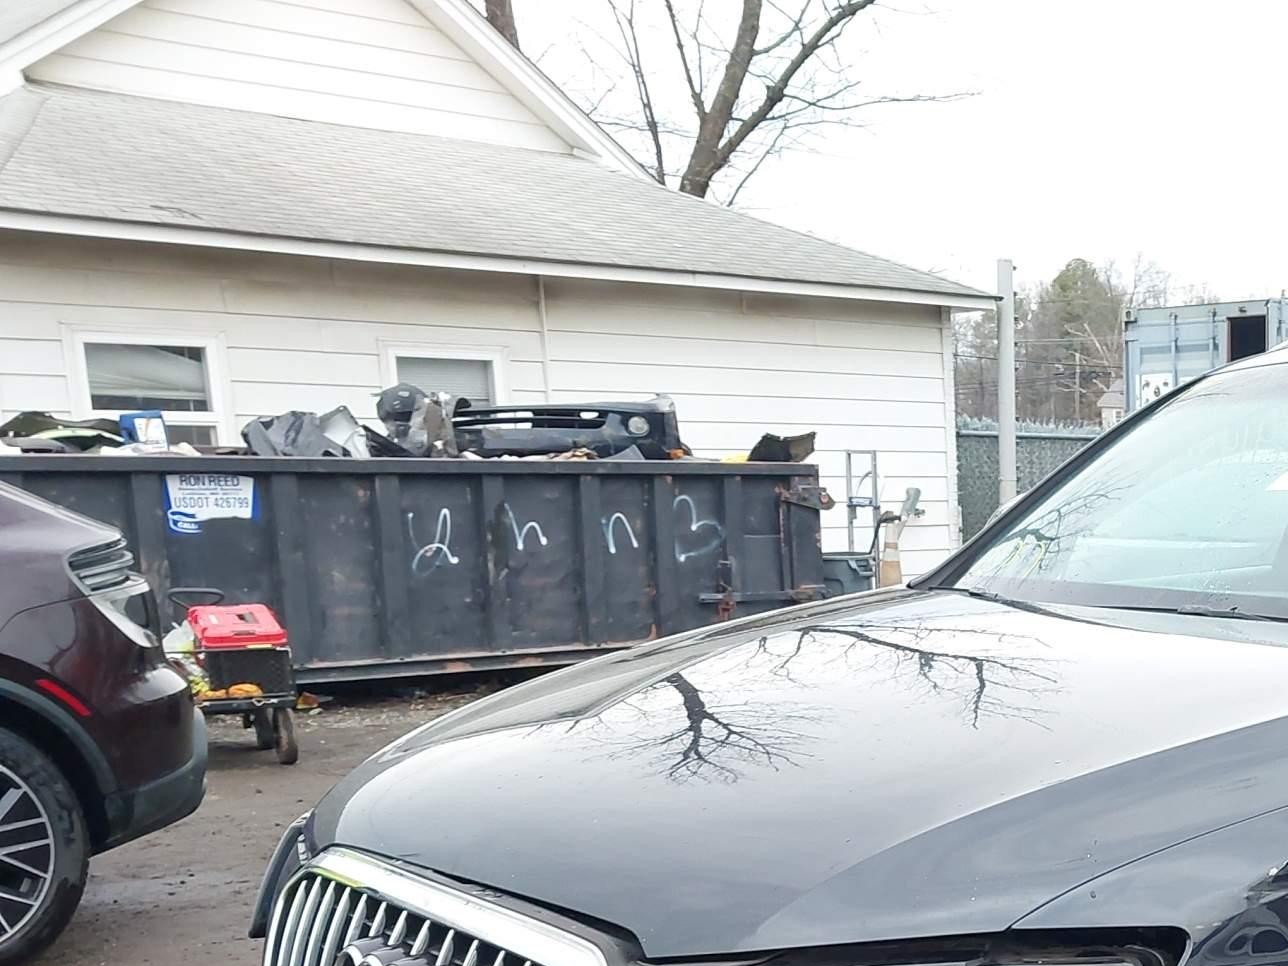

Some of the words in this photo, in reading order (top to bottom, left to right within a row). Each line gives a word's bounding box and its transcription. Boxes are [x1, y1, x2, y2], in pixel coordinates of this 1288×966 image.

[179, 474, 206, 487] RON
[208, 475, 240, 487] REED
[173, 496, 209, 509] USDOT
